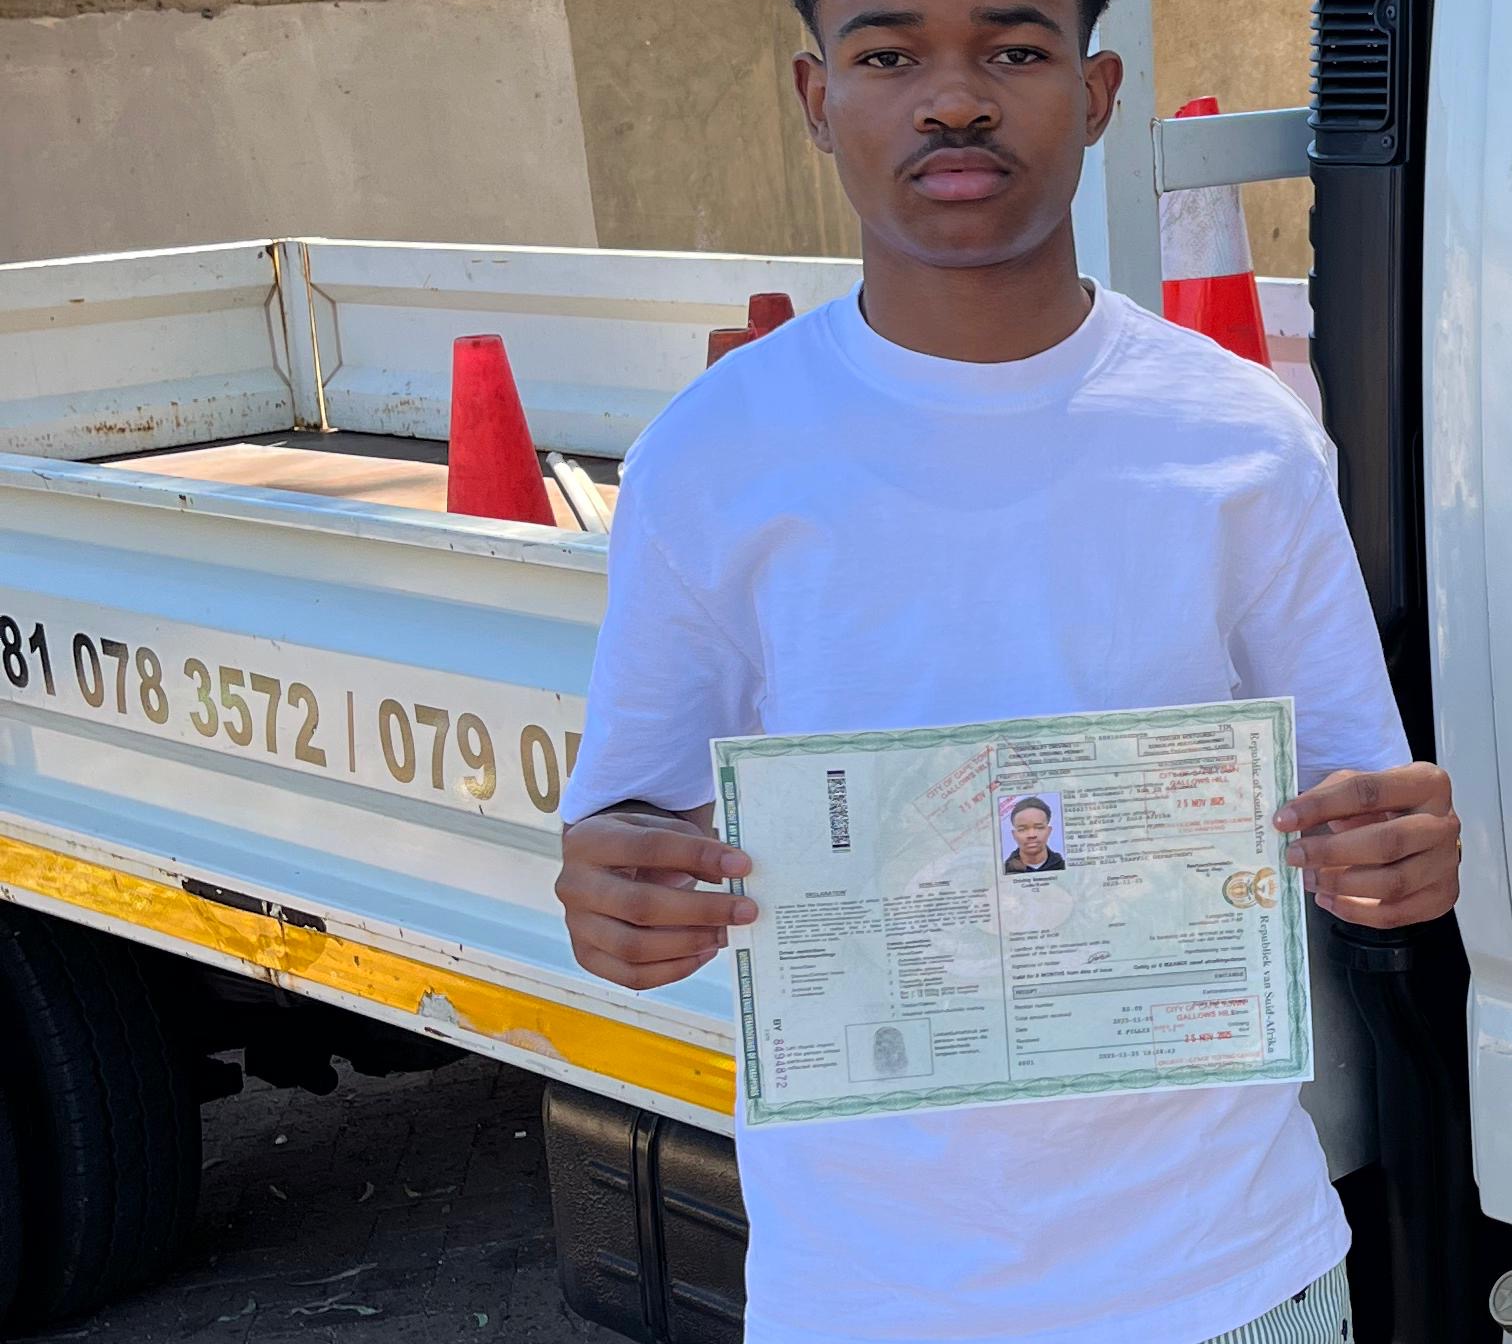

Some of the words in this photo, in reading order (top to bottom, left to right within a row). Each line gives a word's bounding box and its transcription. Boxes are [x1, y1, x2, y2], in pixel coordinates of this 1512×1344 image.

[0, 615, 56, 696] 81
[73, 633, 169, 725] 078
[184, 658, 327, 767] 3572
[378, 698, 497, 800] 079
[1249, 732, 1261, 776] Republic
[1258, 914, 1270, 967] Republiek
